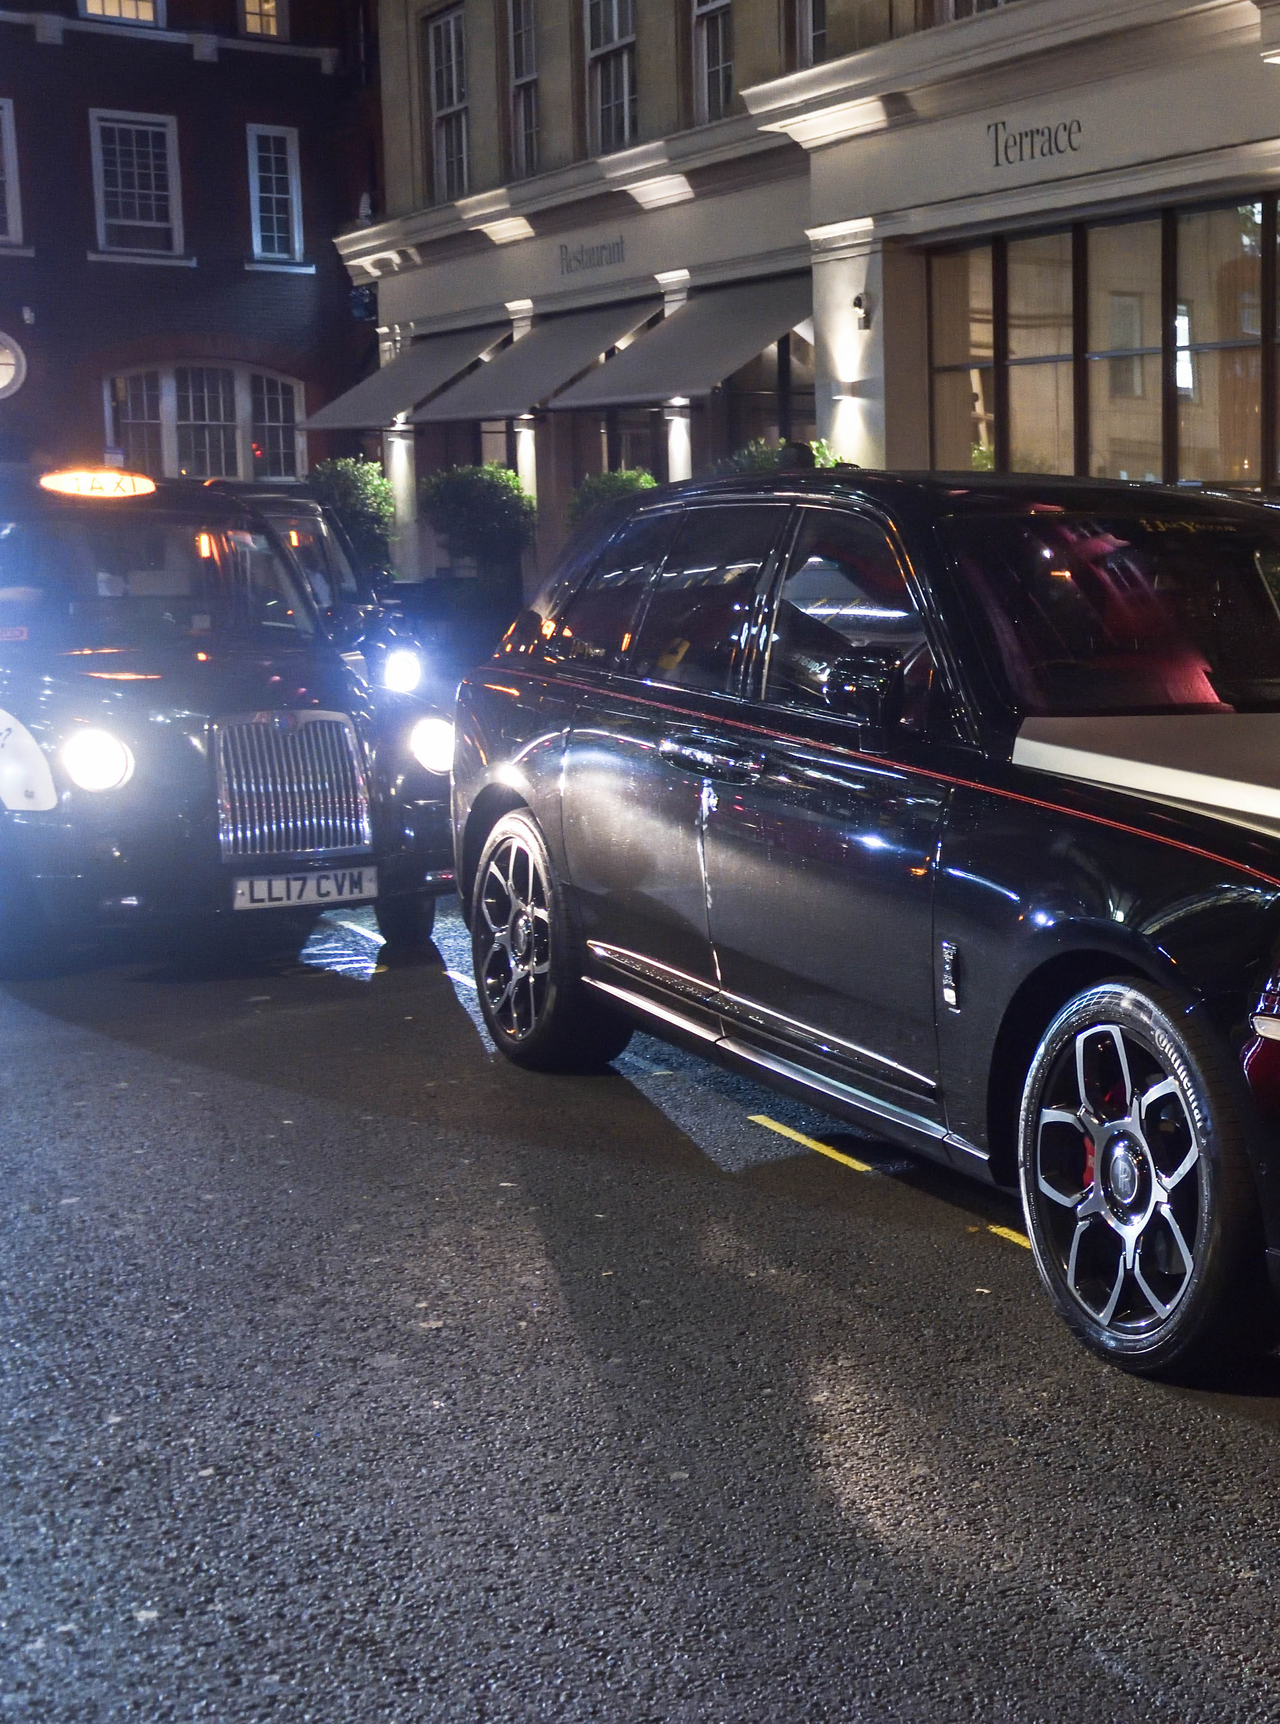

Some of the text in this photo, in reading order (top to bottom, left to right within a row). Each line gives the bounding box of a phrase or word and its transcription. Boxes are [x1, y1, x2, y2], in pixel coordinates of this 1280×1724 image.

[986, 119, 1082, 167] Terrace
[559, 234, 625, 275] Restaurant
[73, 476, 137, 493] TAXI
[249, 870, 363, 904] LL17 CVM
